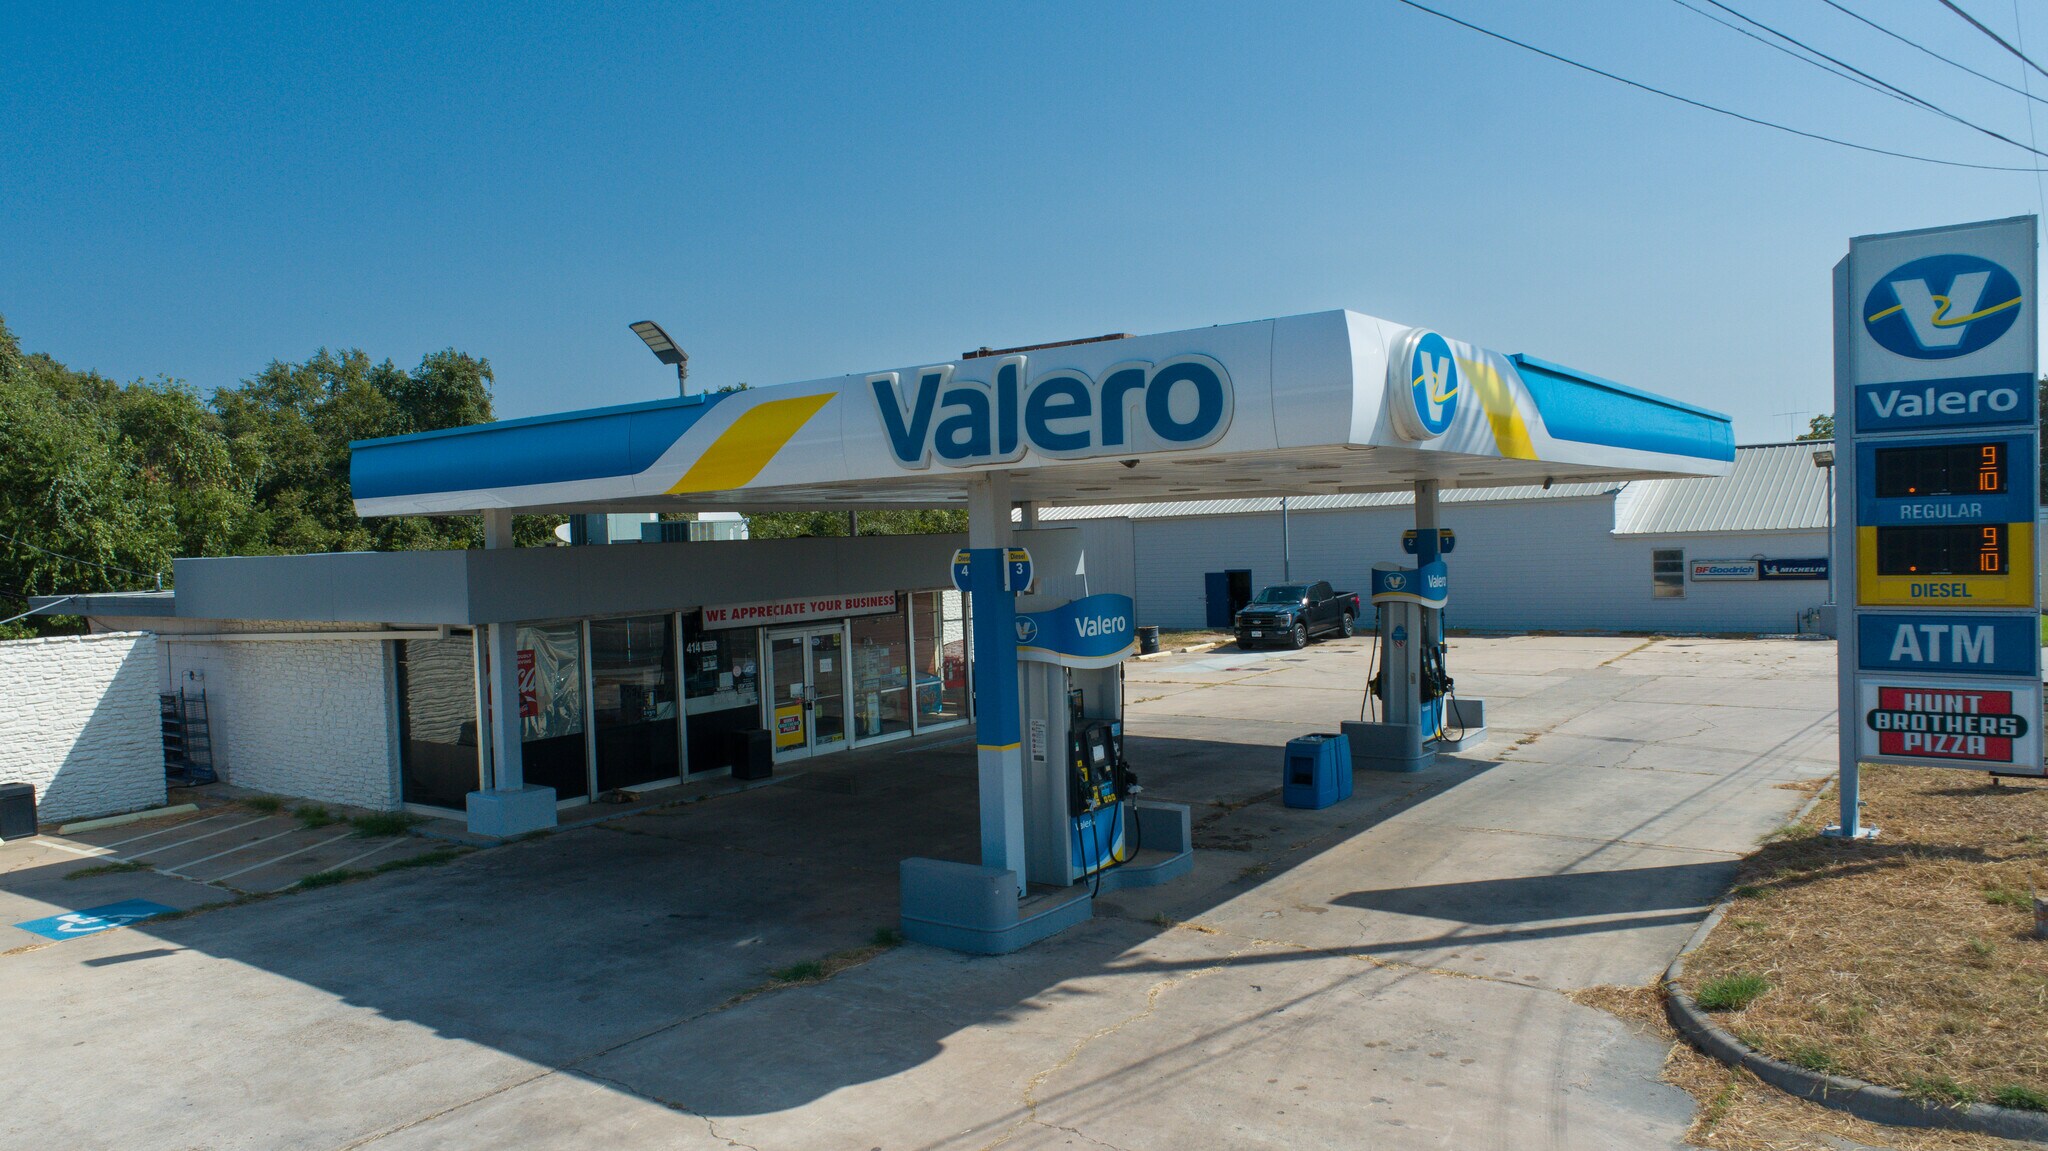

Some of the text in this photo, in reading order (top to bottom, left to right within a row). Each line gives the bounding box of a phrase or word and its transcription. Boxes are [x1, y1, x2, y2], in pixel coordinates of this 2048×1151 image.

[872, 362, 1224, 461] Valero
[1867, 387, 2019, 419] Valero
[1982, 446, 1996, 465] 9
[1979, 471, 1998, 491] 10
[1900, 503, 1982, 519] REGULAR
[1407, 538, 1414, 546] 2
[1983, 527, 1997, 546] 9
[961, 565, 969, 576] 4
[1016, 563, 1023, 575] 3
[1695, 566, 1754, 574] BFGoodrich
[1980, 553, 1998, 571] 10
[1428, 574, 1446, 588] Valero
[1911, 583, 1972, 598] DIESEL
[706, 595, 895, 622] WE APPRECIATE YOUR BUSINESS
[1075, 615, 1126, 638] Valero
[686, 641, 701, 654] 414
[1889, 624, 1995, 664] ATM
[1904, 693, 1983, 714] HUNT
[1875, 712, 2017, 736] BROTHERS
[1904, 733, 1986, 755] PIZZA
